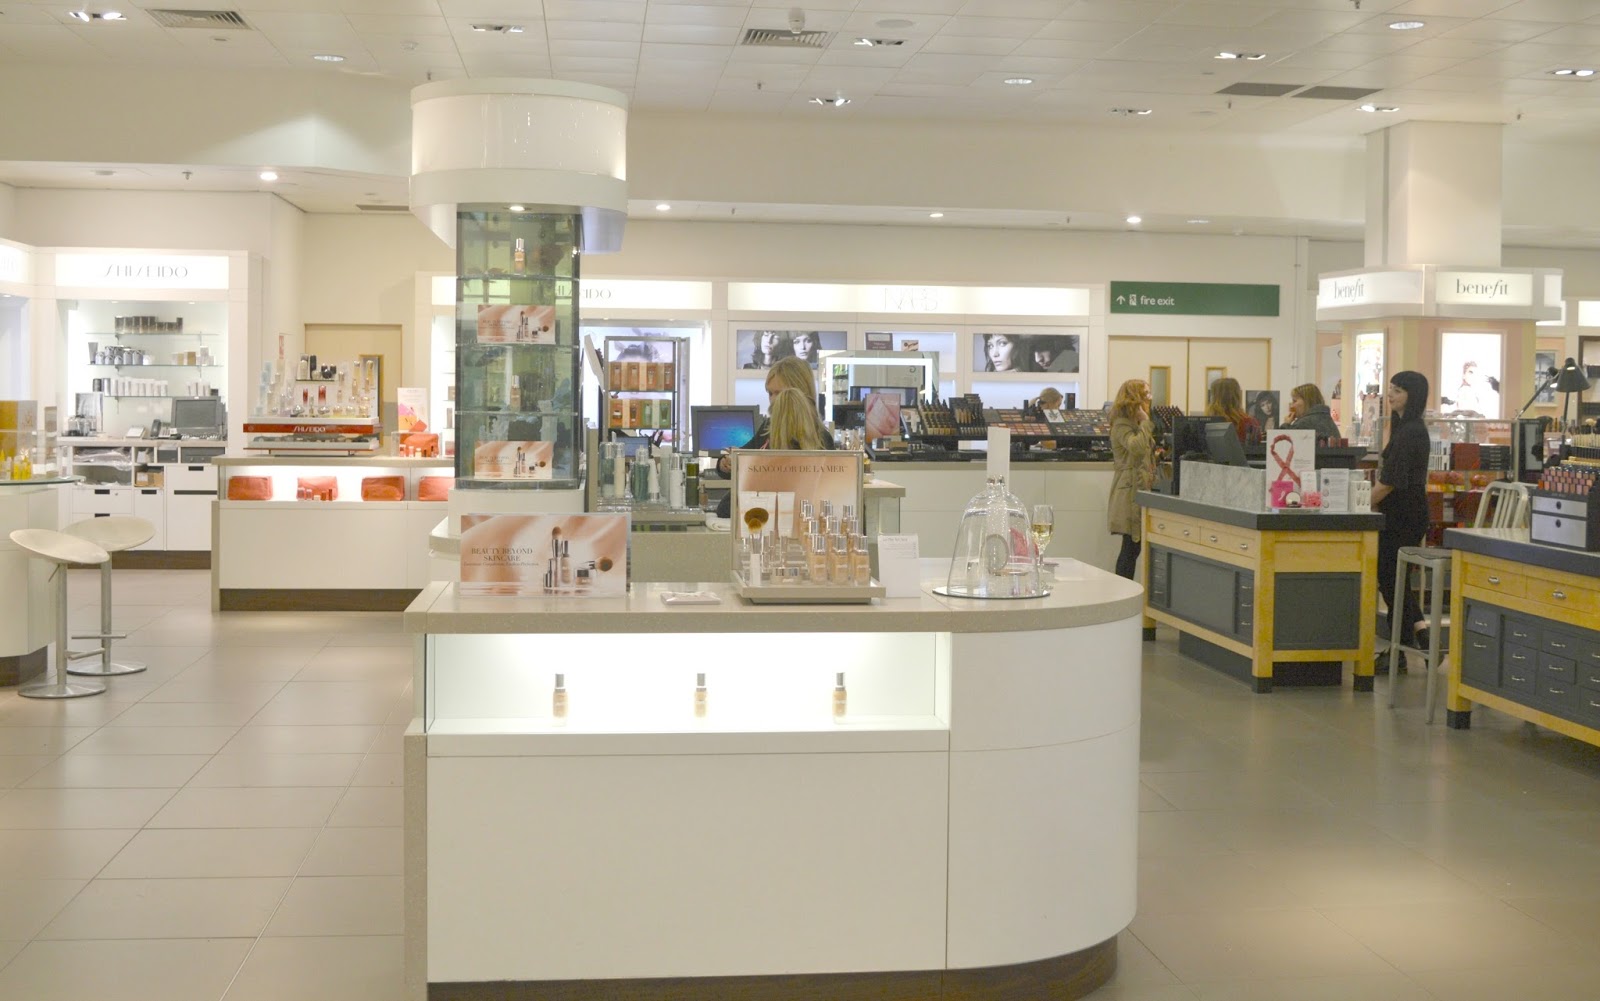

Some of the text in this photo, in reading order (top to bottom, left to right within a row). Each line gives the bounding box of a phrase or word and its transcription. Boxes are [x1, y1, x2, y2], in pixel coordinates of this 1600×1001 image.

[104, 264, 188, 278] SHISEIDO
[1334, 278, 1365, 302] benefit
[1456, 278, 1508, 299] benefit
[1140, 294, 1175, 306] fire exit
[747, 465, 797, 473] SKINCOLOR
[799, 465, 811, 473] DE
[813, 465, 825, 473] LA
[471, 547, 533, 555] BEAUTY BEYOND
